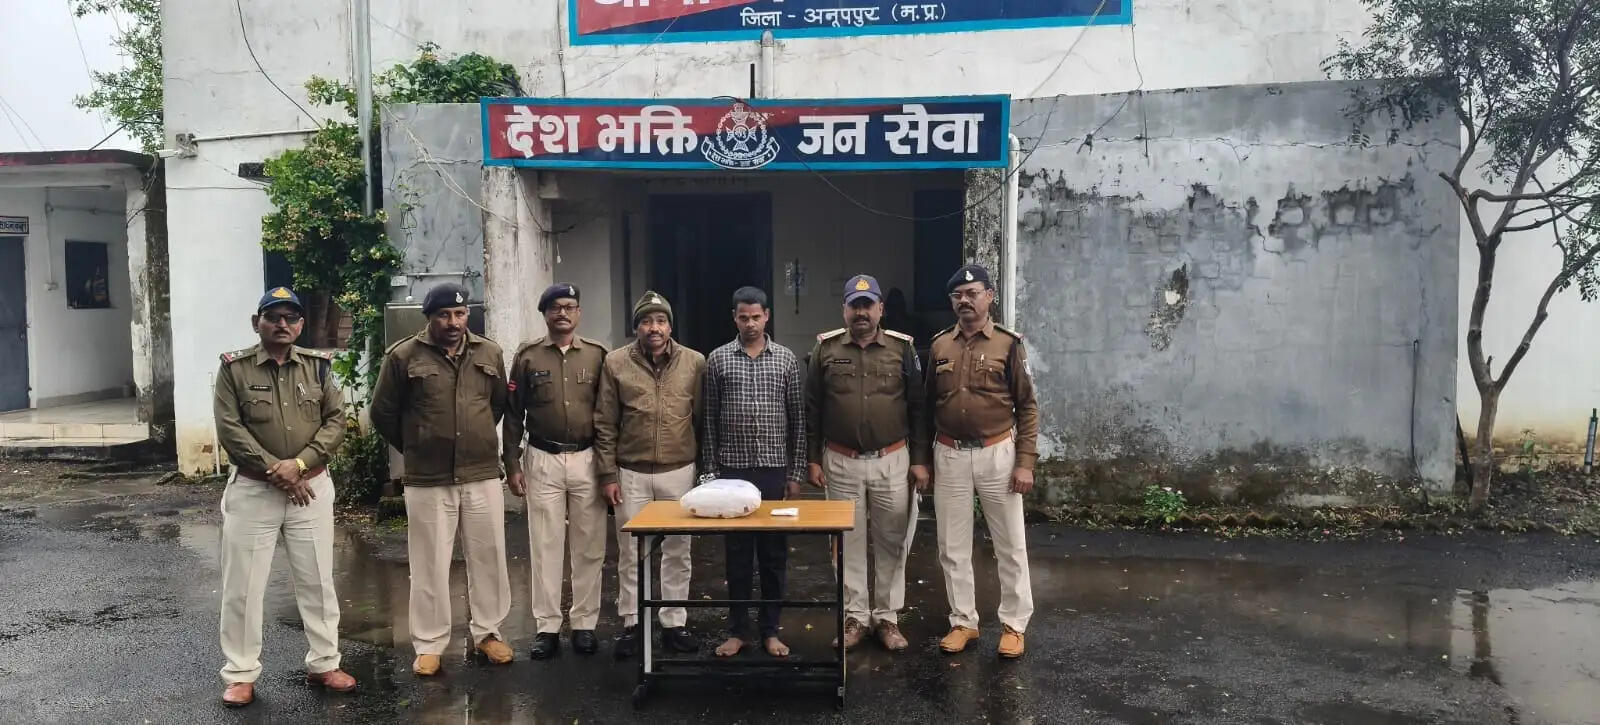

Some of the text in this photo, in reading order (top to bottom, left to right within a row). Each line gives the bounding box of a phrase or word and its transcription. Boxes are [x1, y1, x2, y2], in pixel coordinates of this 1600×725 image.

[740, 7, 782, 27] जिला
[803, 6, 880, 28] अनूपपुर
[505, 103, 985, 159] देश भक्ति जन सेवा
